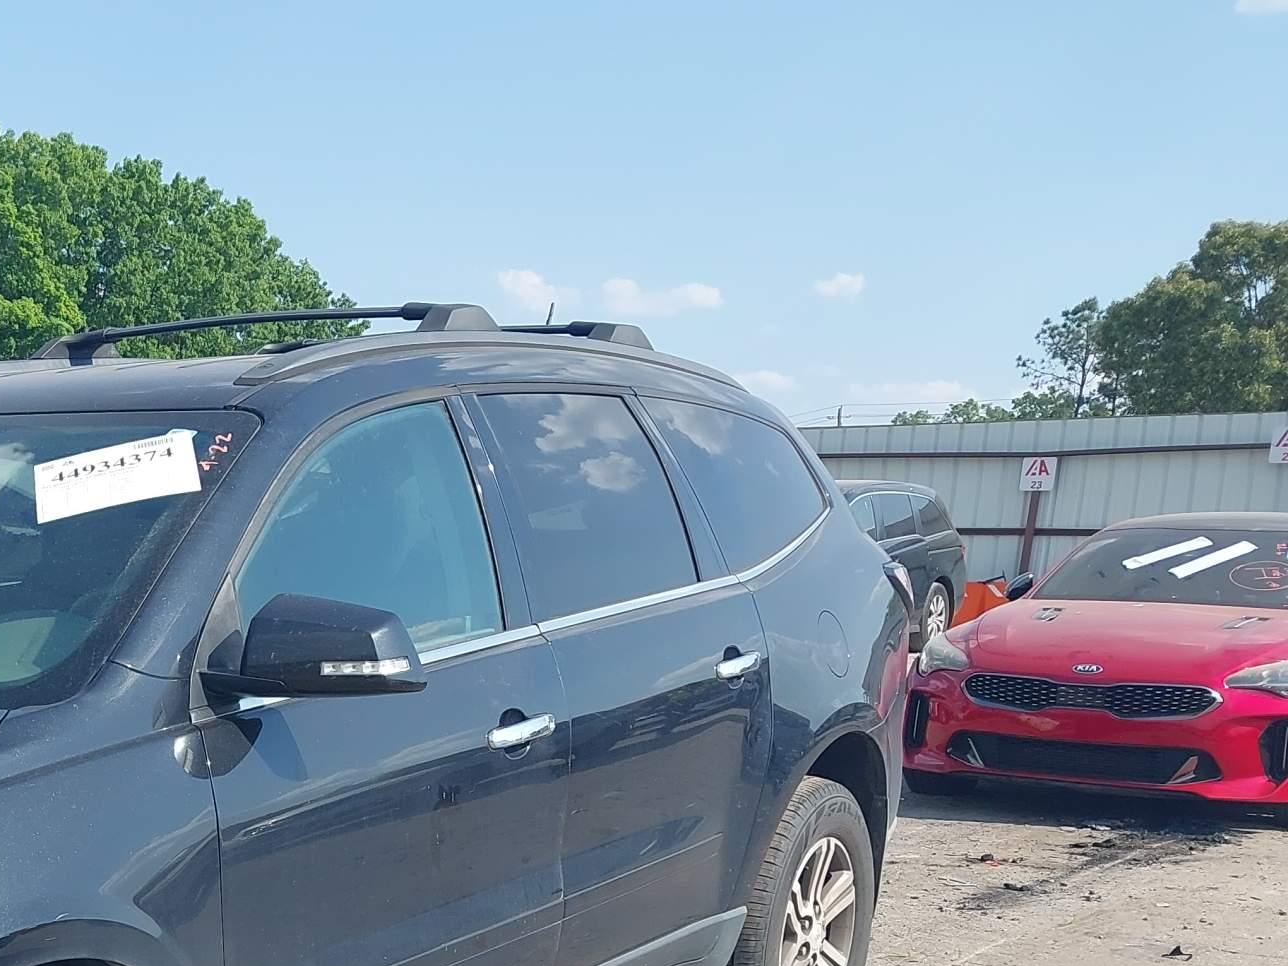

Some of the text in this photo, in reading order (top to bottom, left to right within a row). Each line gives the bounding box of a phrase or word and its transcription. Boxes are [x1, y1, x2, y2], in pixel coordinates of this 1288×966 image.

[52, 447, 174, 481] 44934374
[1030, 480, 1043, 489] 23
[1076, 664, 1097, 672] KIA
